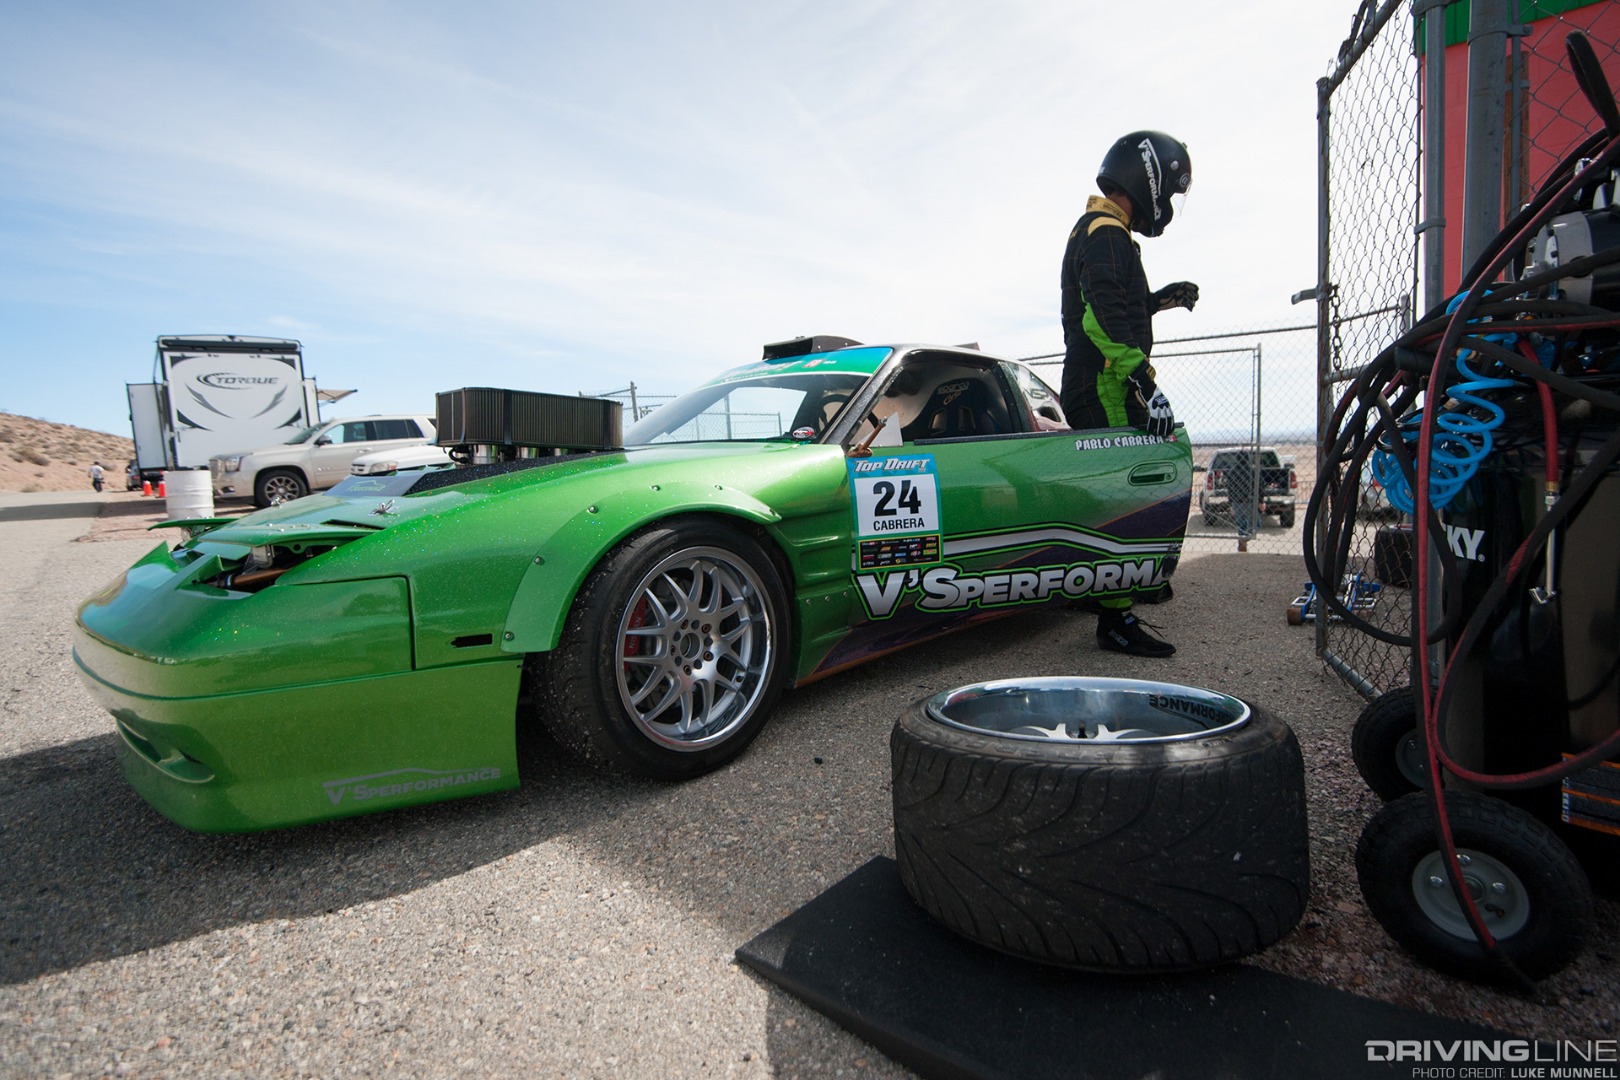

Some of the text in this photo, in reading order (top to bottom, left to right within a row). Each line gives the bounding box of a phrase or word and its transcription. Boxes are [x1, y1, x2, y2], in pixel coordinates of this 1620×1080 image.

[1075, 434, 1163, 451] PABLO CABRERA
[854, 457, 931, 473] TOP DRIFT
[873, 480, 922, 517] 24
[873, 517, 925, 531] CABRERA
